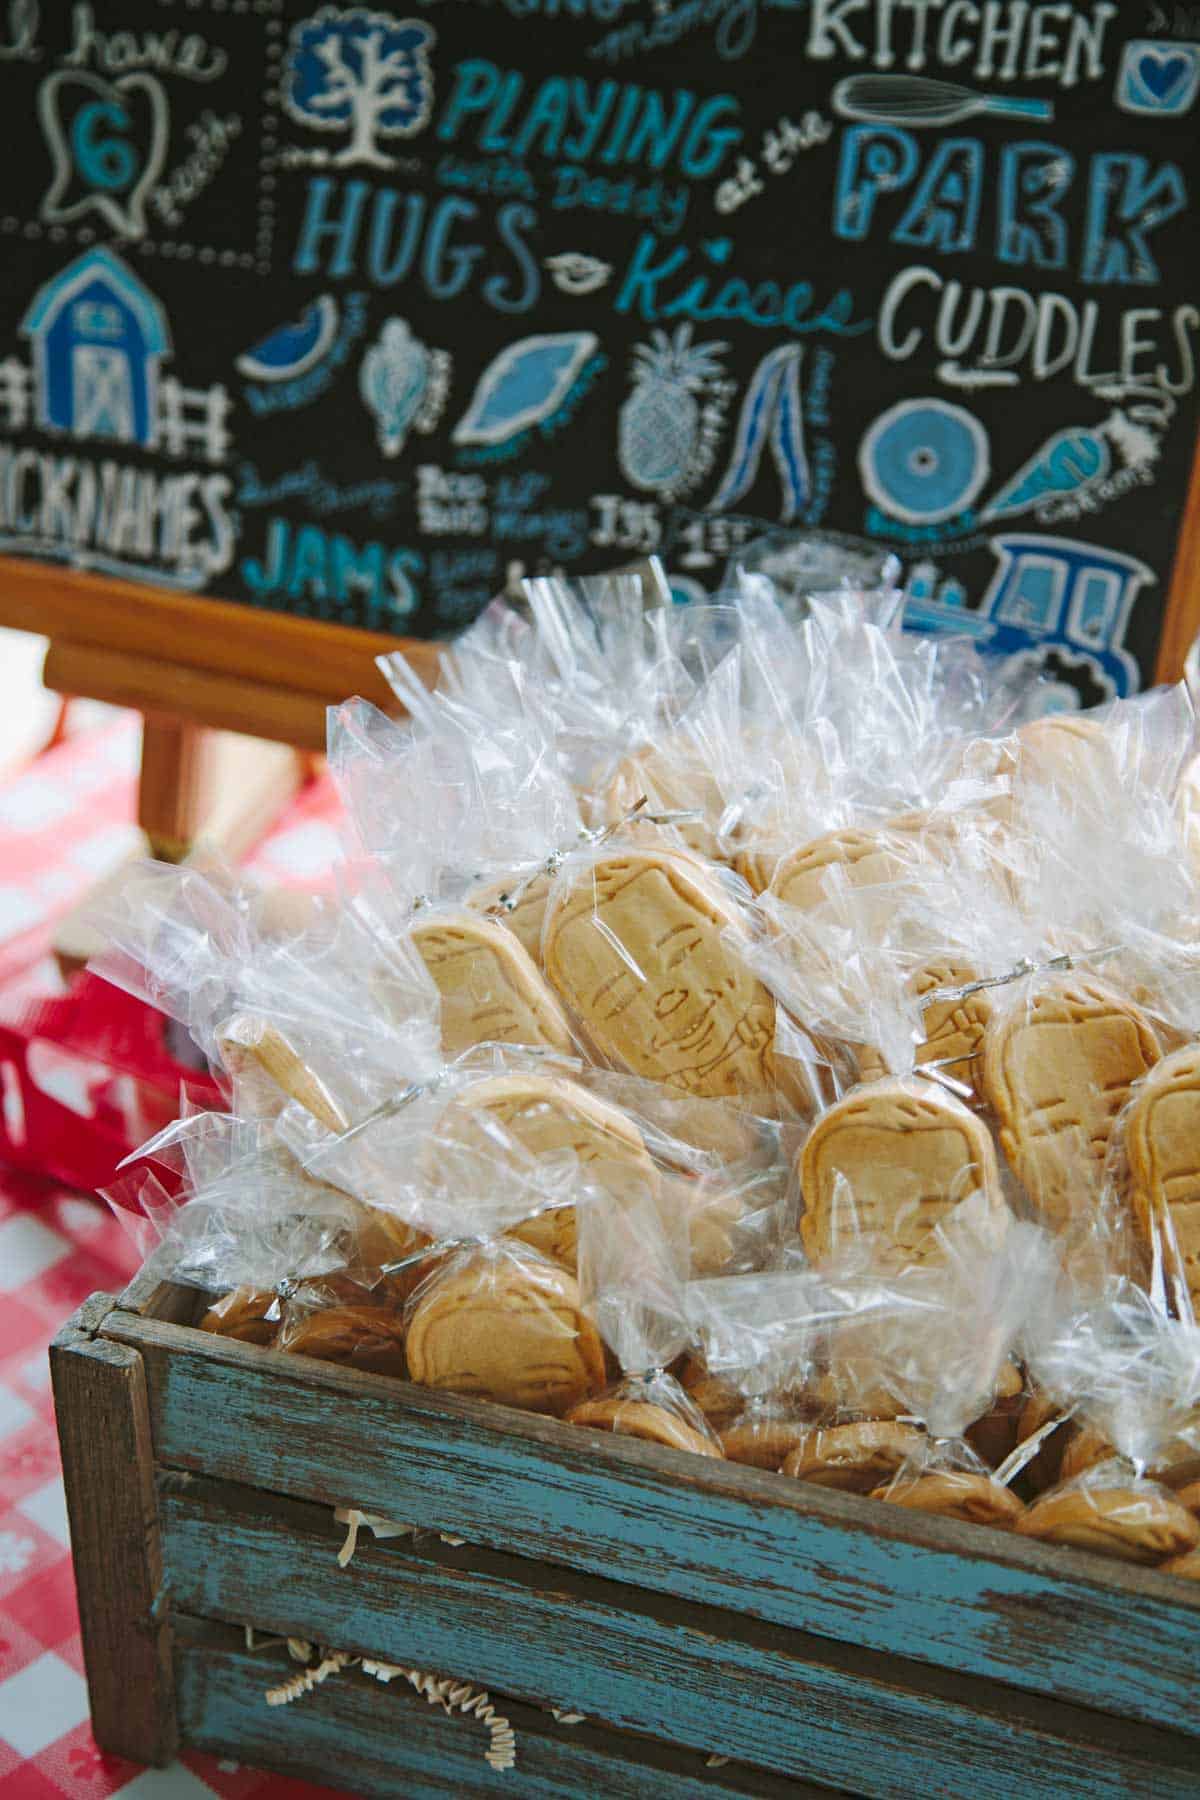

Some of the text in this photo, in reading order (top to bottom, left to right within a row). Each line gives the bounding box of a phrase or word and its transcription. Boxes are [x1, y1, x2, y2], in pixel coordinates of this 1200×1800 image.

[806, 0, 1117, 88] KITCHEN
[71, 102, 138, 190] 6
[436, 58, 745, 178] PLAYING
[761, 110, 833, 175] the
[293, 175, 542, 314] HUGS
[831, 122, 1188, 285] PARK
[878, 265, 1200, 397] CUDDLES
[0, 443, 235, 575] ICKNAMES
[241, 516, 424, 616] JAMS
